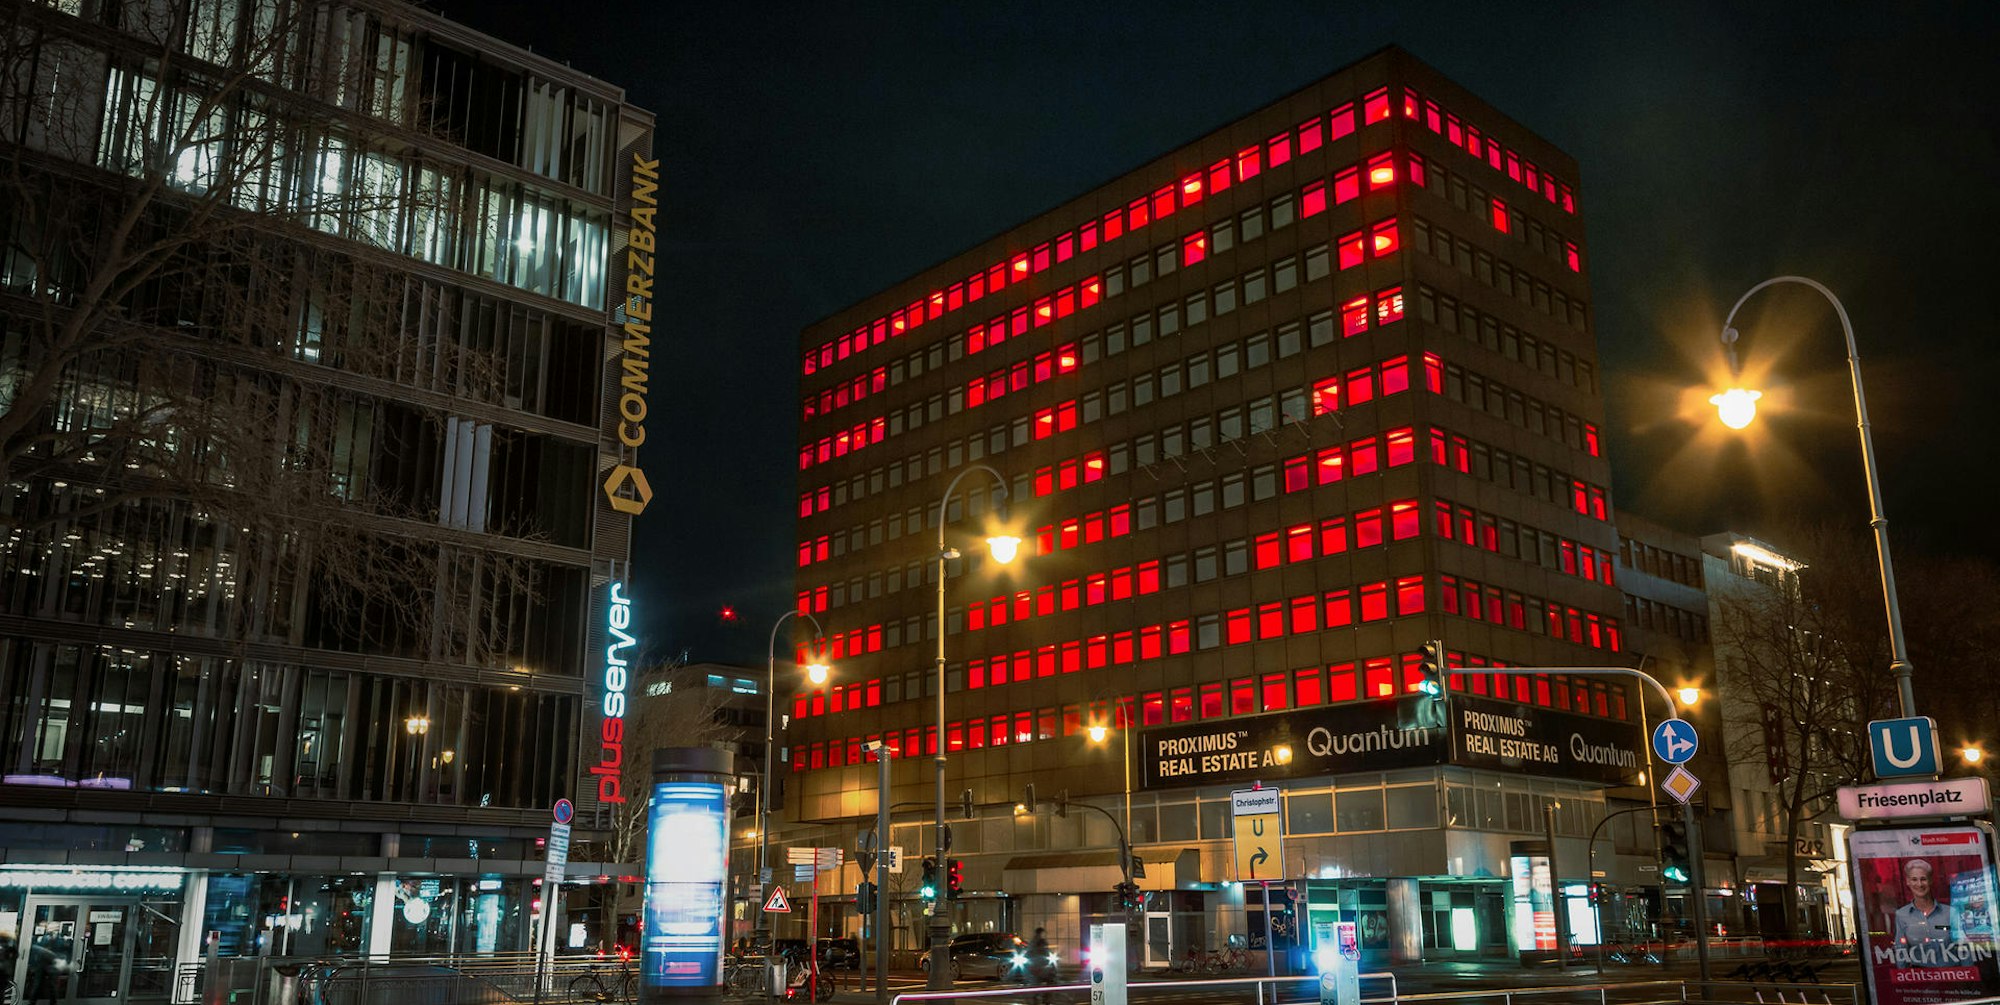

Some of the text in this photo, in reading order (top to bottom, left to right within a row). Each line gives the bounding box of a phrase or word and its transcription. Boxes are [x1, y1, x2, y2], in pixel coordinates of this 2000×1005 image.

[618, 153, 660, 447] COMMERZBANK
[590, 583, 636, 803] plusserver
[1307, 724, 1430, 757] Quantum
[1466, 734, 1559, 764] REAL ESTATE AG
[1570, 732, 1637, 768] Quantum
[1882, 726, 1922, 769] U
[1159, 756, 1198, 777] REAL
[1202, 751, 1259, 773] ESTATE
[1235, 797, 1277, 807] Christophstr.
[1858, 789, 1963, 808] Friesenplatz
[1252, 818, 1264, 837] U
[1896, 969, 1975, 982] achtsamer.
[1092, 991, 1103, 1001] 57
